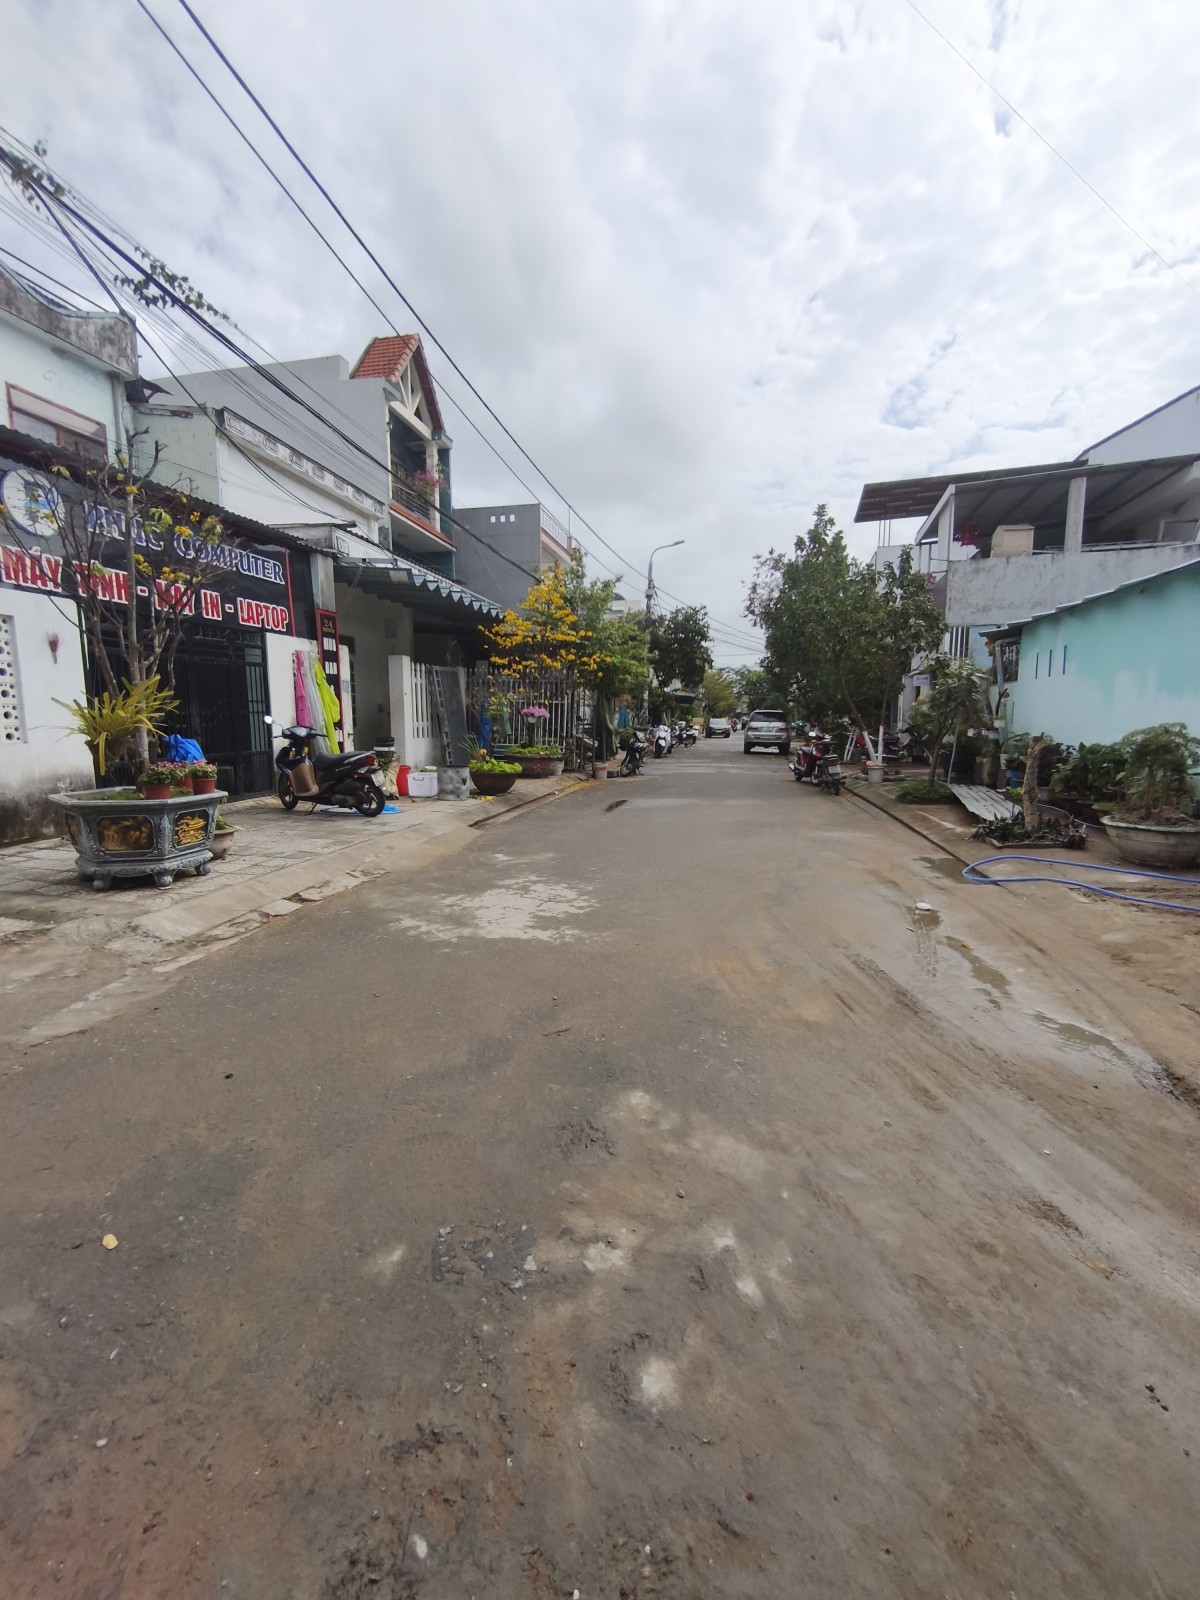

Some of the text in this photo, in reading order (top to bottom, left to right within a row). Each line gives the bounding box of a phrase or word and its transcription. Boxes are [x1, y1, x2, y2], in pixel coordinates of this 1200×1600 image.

[0, 544, 63, 592] MÁY
[201, 589, 222, 620] IN
[237, 597, 289, 632] LAPTOP
[174, 533, 286, 585] COMPUTER
